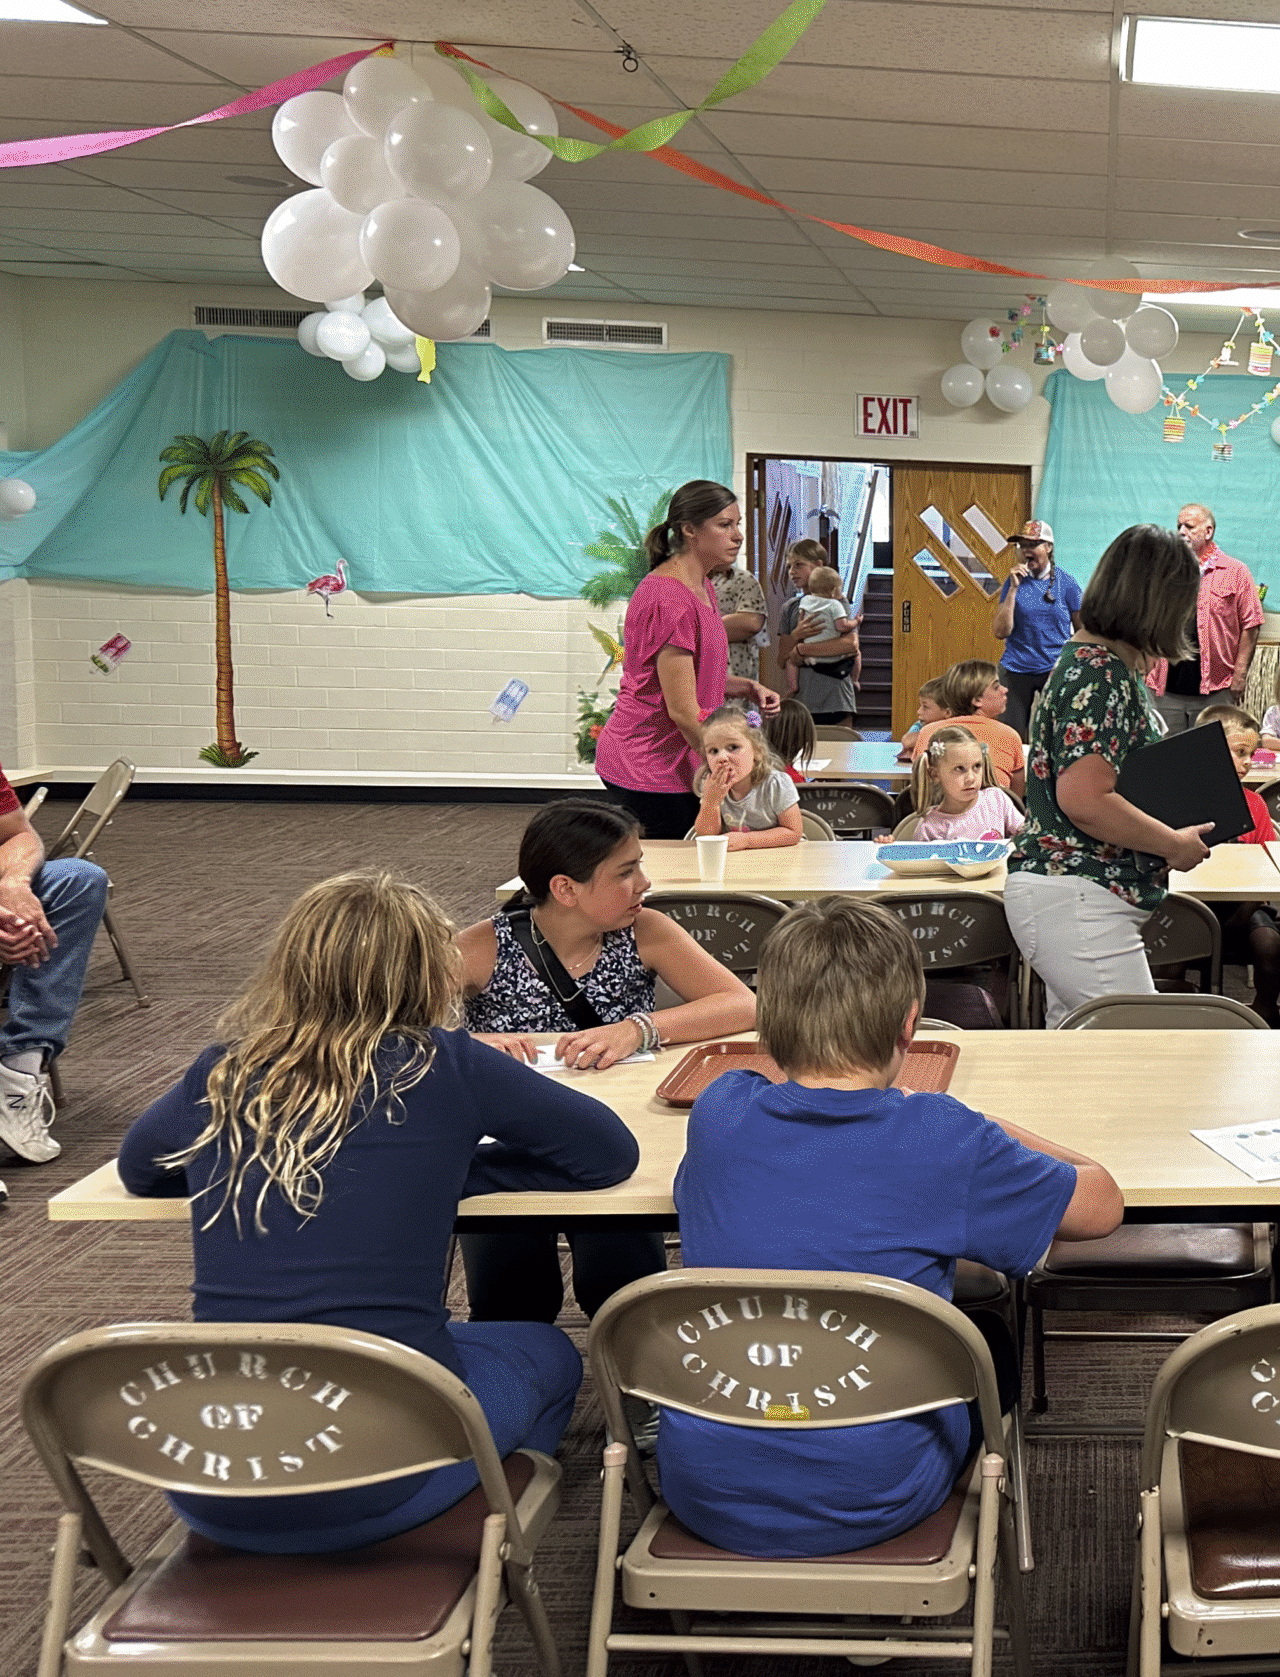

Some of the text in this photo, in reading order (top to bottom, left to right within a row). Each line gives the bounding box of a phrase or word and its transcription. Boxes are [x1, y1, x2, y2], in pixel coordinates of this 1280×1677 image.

[863, 397, 912, 435] EXIT
[803, 789, 862, 804] HURCH
[817, 802, 836, 811] OF
[665, 904, 756, 933] HURCH
[912, 926, 940, 939] OF
[690, 929, 717, 941] OF
[929, 935, 970, 963] IST
[677, 1294, 881, 1352] CHURCH
[747, 1342, 802, 1367] OF
[120, 1352, 352, 1412] CHURCH
[682, 1353, 873, 1414] CHRIST
[200, 1403, 263, 1430] OF
[128, 1415, 344, 1482] CHRIST
